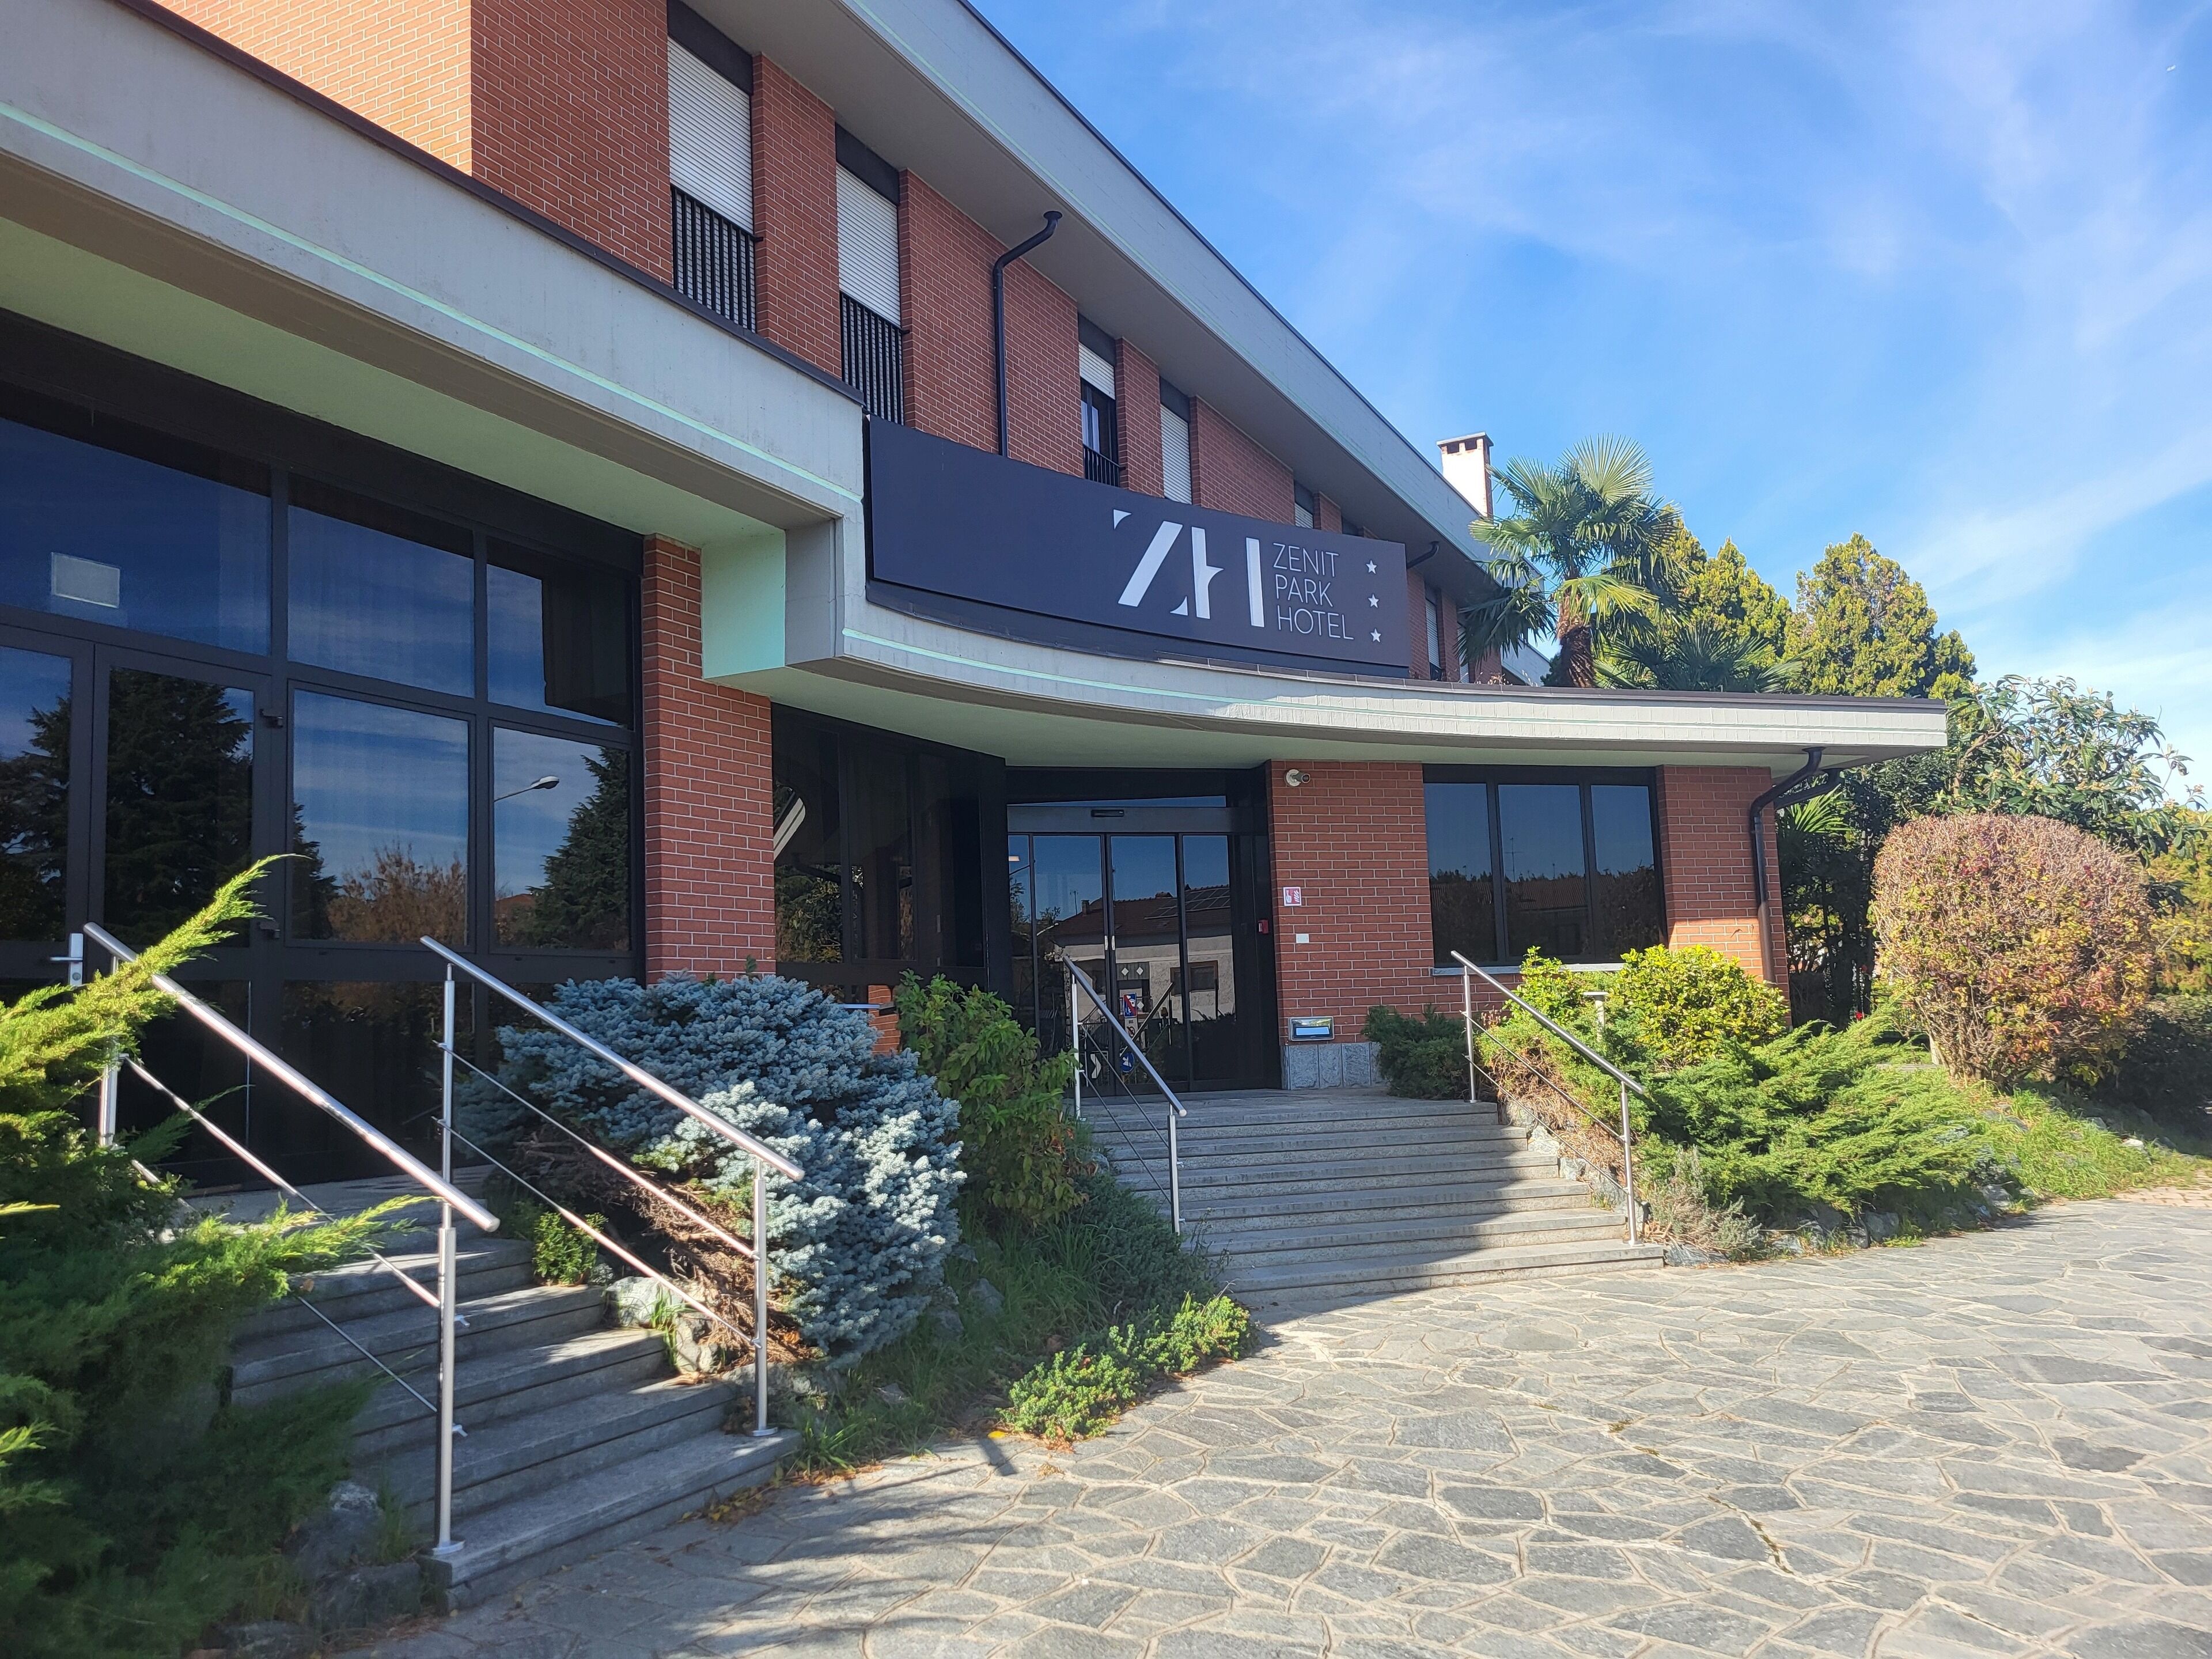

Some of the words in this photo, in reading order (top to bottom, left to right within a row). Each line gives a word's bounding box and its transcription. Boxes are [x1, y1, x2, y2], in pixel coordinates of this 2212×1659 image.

[1272, 542, 1339, 577] ZENIT
[1275, 573, 1334, 608] PARK
[1277, 604, 1354, 641] HOTEL
